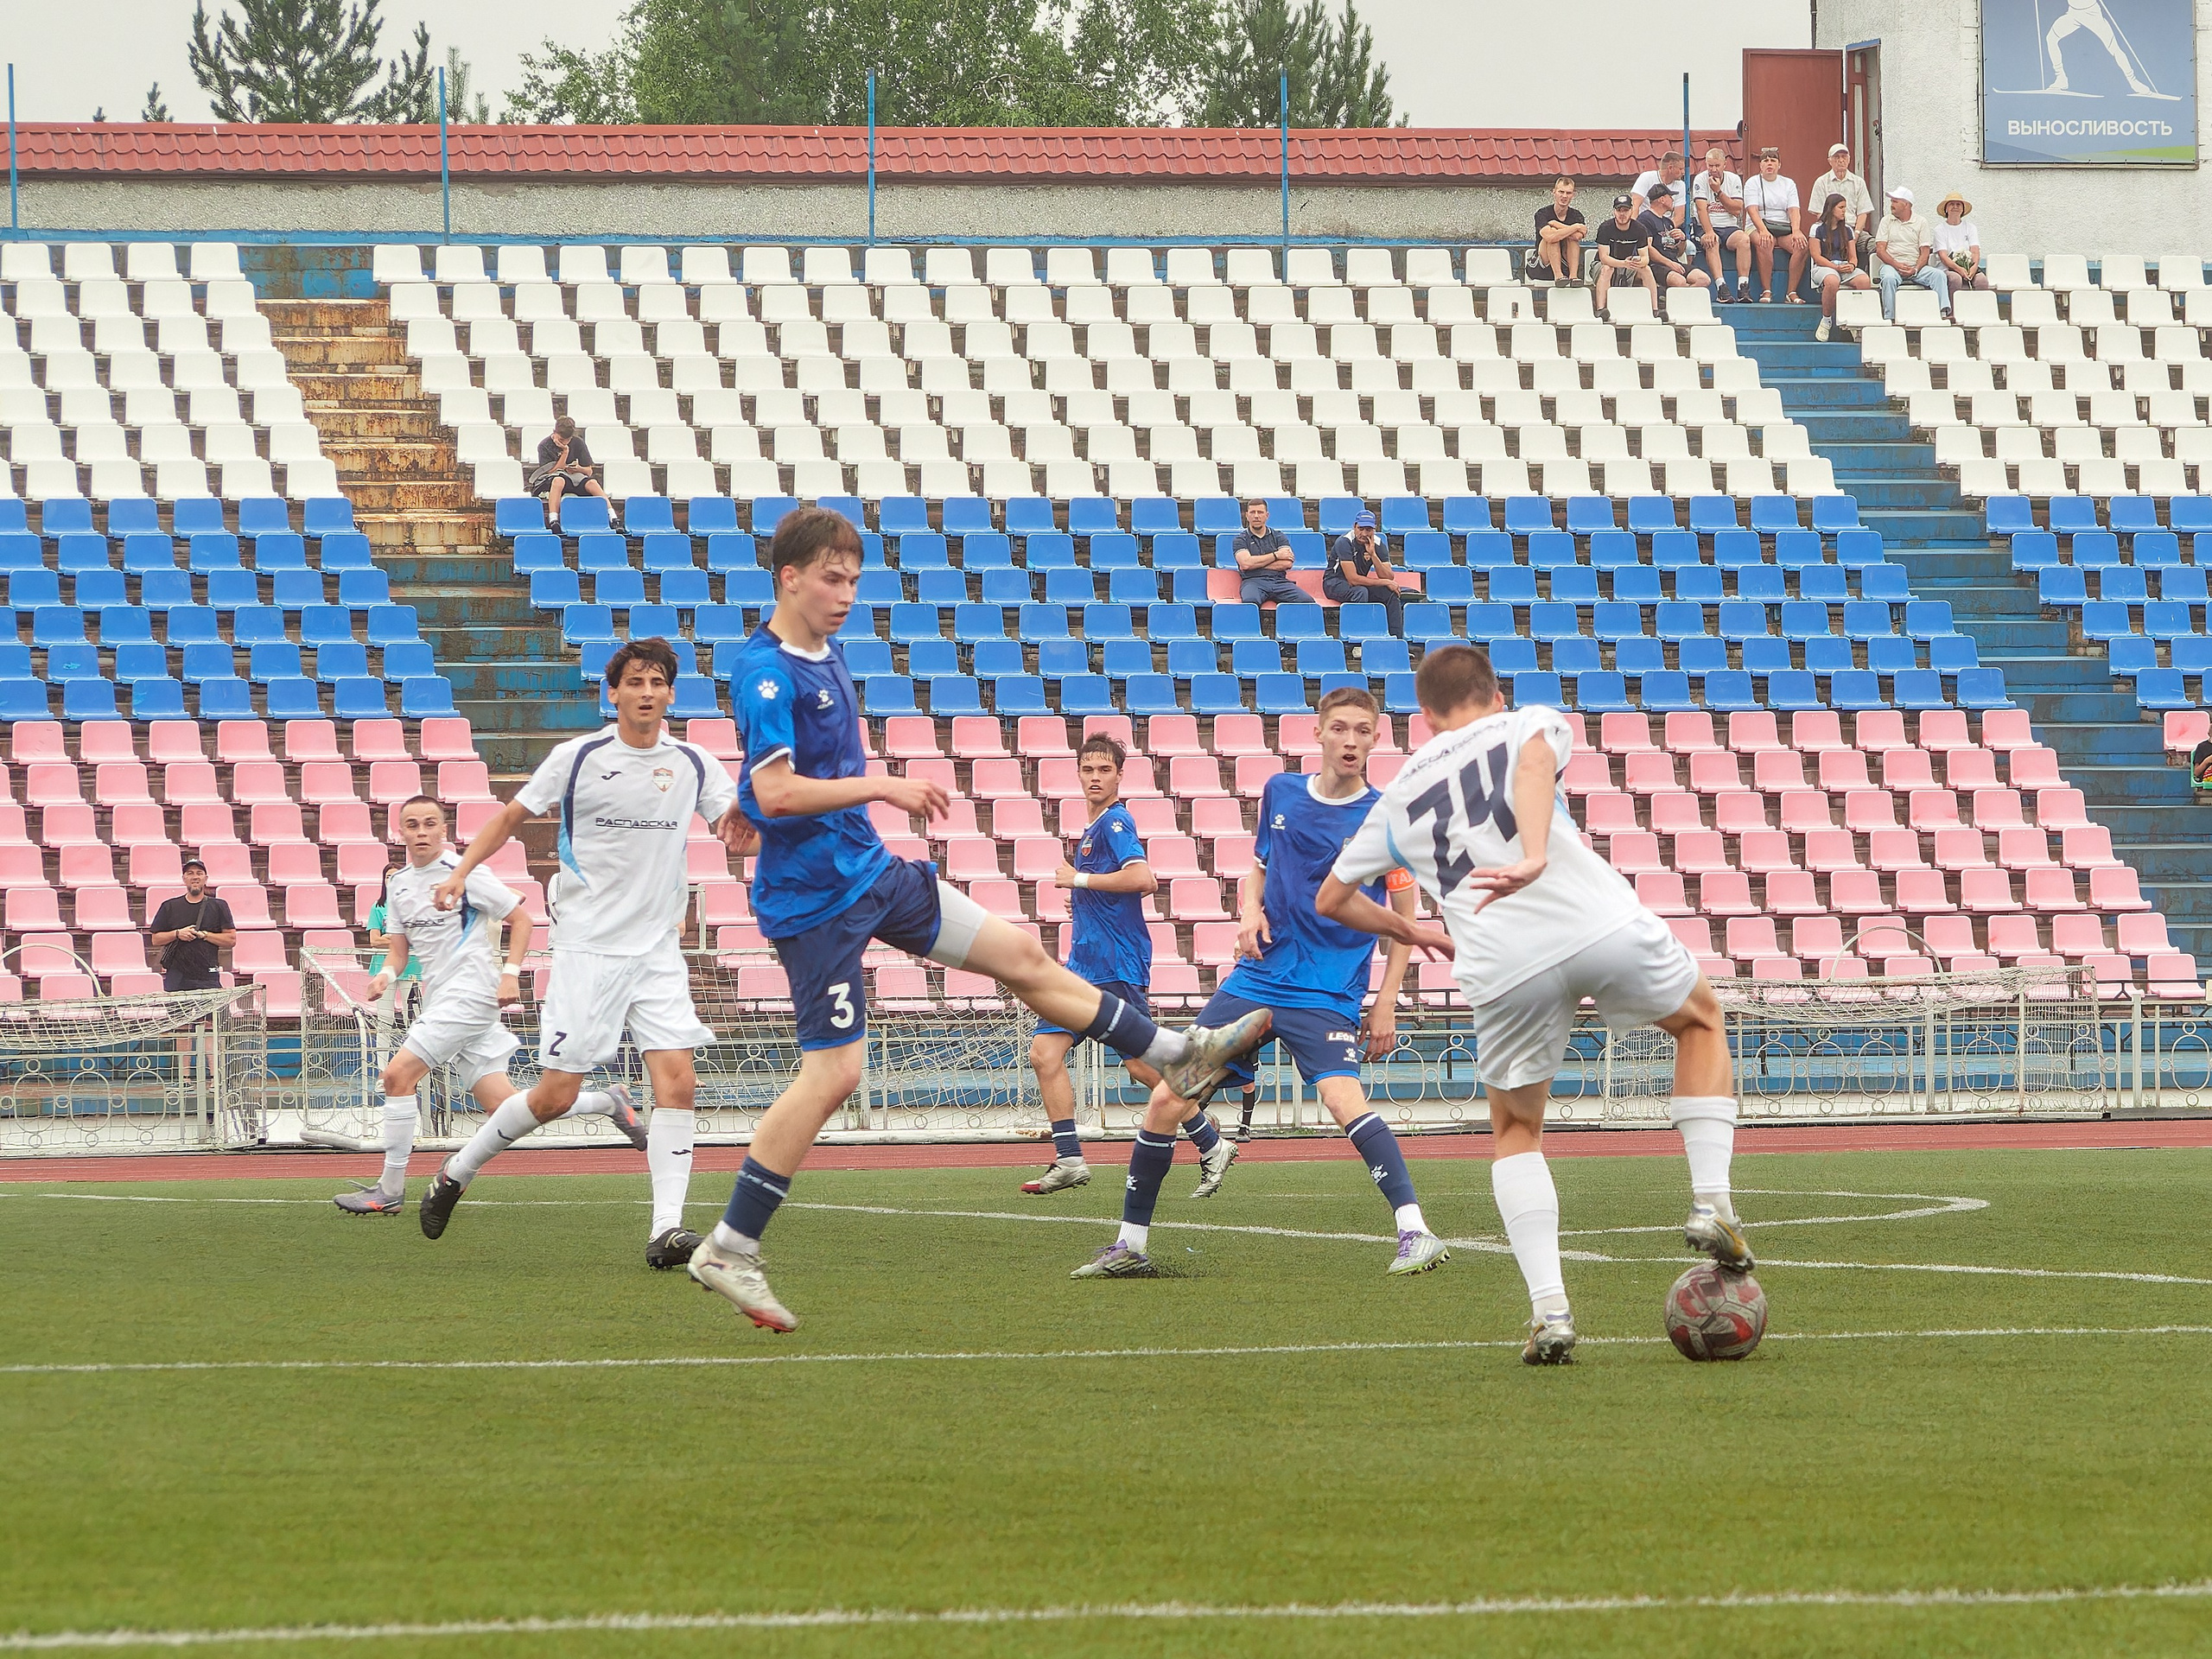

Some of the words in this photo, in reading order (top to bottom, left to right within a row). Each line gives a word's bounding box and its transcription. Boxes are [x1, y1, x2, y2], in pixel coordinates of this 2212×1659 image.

[2007, 119, 2173, 137] ВЫНОСЛИВОСТЬ
[1406, 742, 1518, 899] 24
[827, 982, 855, 1029] 3
[548, 1031, 568, 1057] 2
